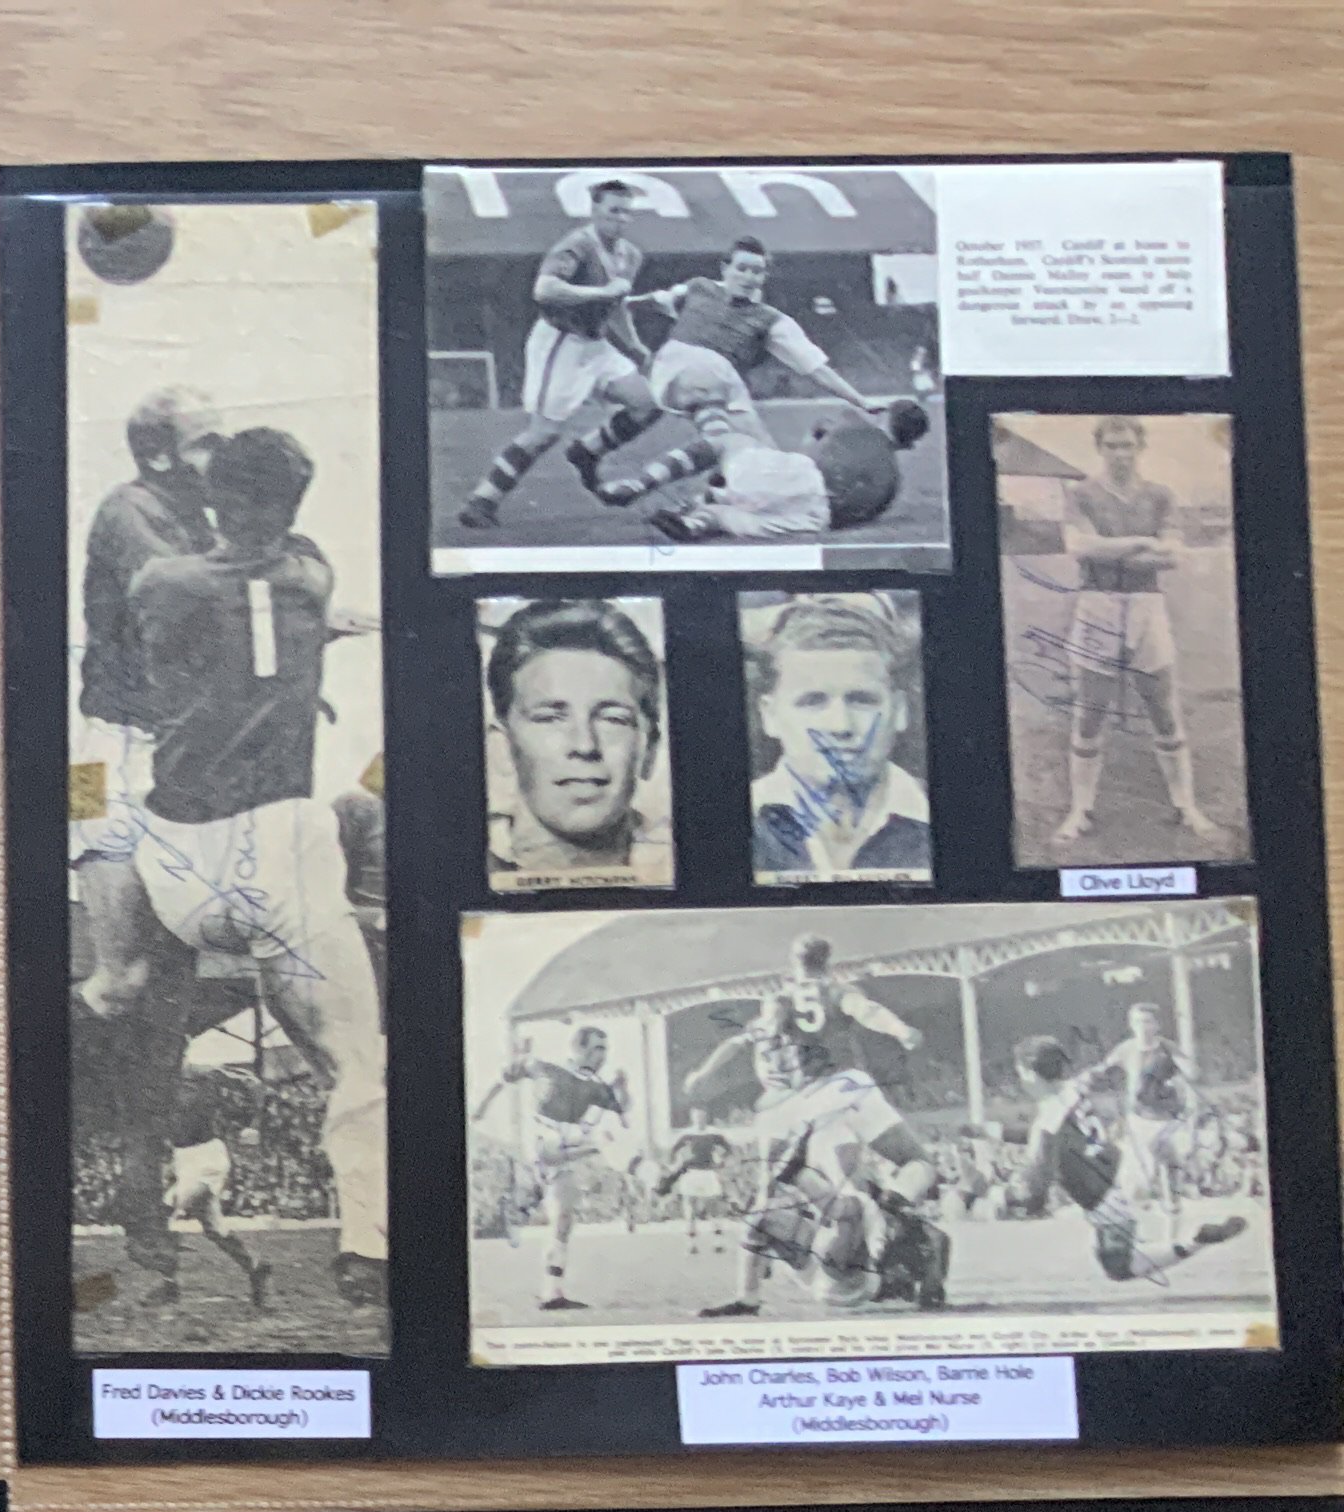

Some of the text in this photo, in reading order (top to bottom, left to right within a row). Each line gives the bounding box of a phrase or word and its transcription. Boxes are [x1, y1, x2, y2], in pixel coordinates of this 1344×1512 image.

[1079, 872, 1176, 892] Clive Lloyd
[699, 1363, 1035, 1387] John Charles, Bob Wilson, Barrie Hole
[101, 1383, 357, 1402] Fred Davies & Dickie Rookes
[757, 1389, 982, 1412] Arthur Kaye & Mel Nurse
[151, 1408, 310, 1430] (Middlesborough)
[791, 1413, 951, 1436] (Middlesborough)
